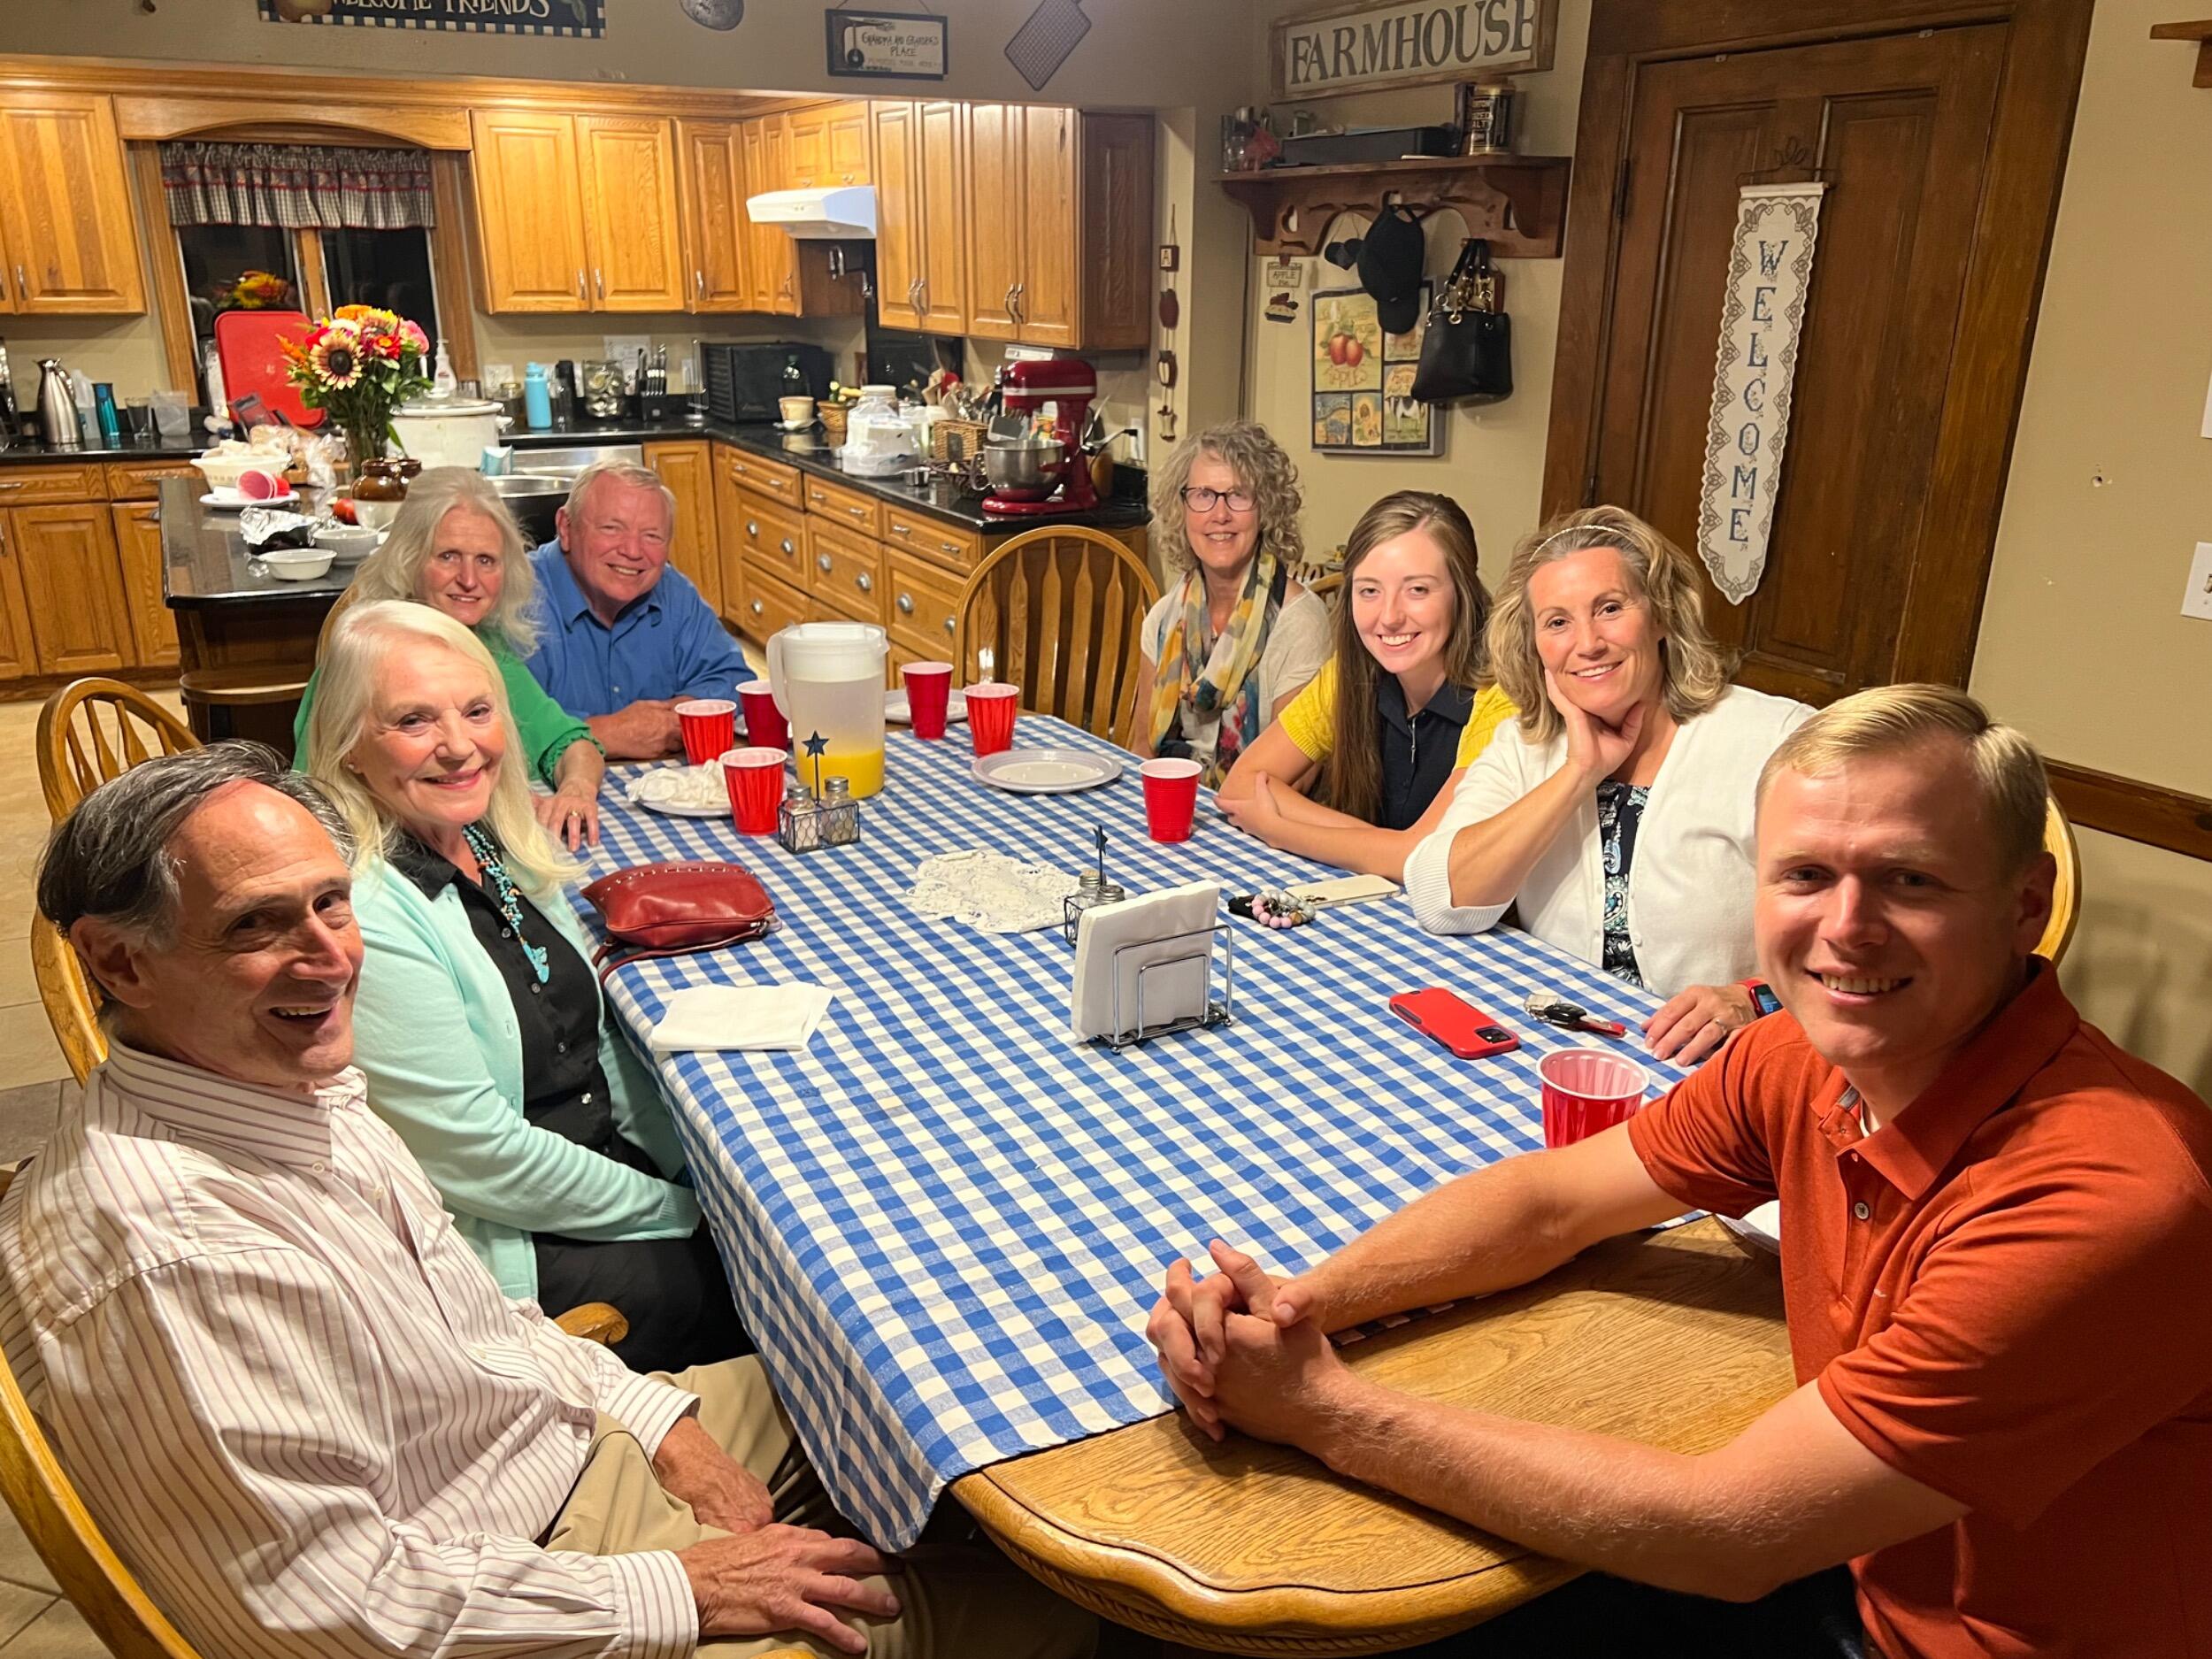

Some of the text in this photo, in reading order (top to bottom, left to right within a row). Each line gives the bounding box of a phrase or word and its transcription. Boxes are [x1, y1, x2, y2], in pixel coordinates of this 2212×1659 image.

[890, 46, 917, 57] PLACE
[1290, 0, 1532, 84] FARMHOUSE
[1728, 241, 1788, 542] WELCOME
